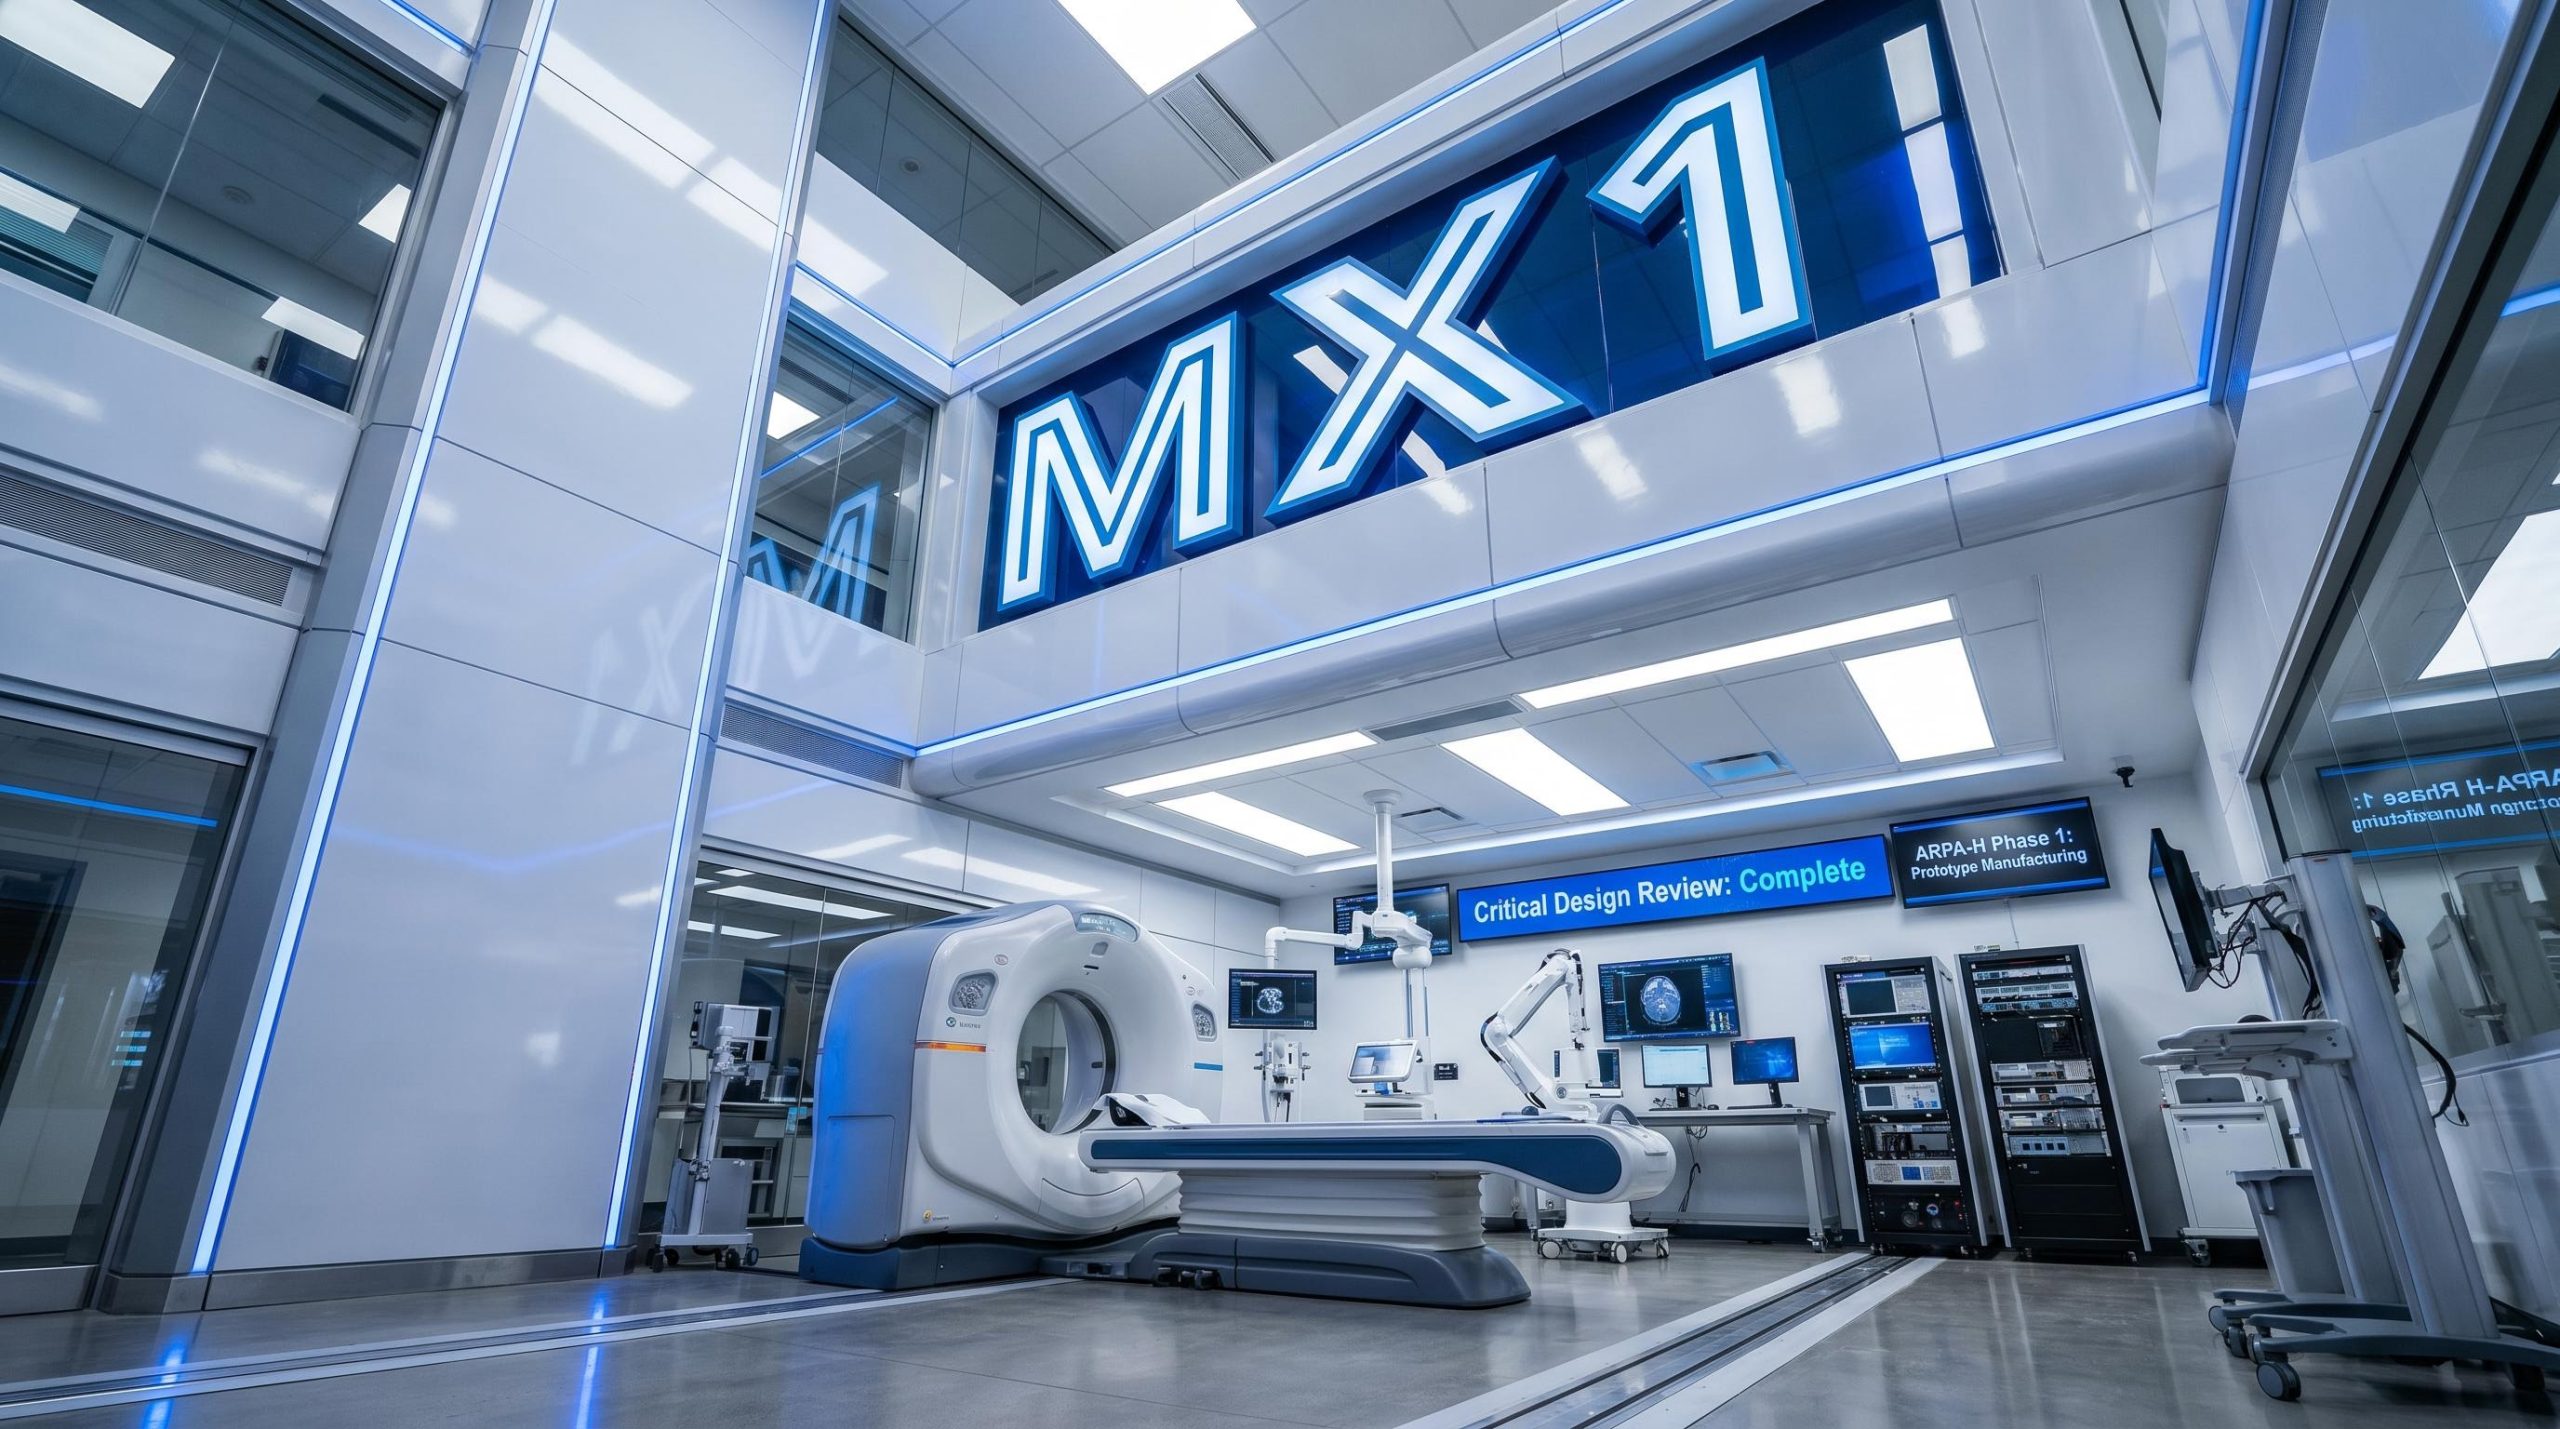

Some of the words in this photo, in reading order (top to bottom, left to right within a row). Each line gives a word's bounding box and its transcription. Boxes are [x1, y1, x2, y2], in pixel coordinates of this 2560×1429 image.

[998, 56, 1813, 611] MX1
[1911, 861, 1978, 879] Prototype
[1981, 850, 2088, 872] Manufacturing
[1915, 838, 1987, 862] ARPA-H
[1991, 831, 2050, 851] Phase
[2055, 827, 2073, 845] 1:
[1474, 895, 1547, 923] Critical
[1555, 887, 1631, 915] Design
[1638, 876, 1732, 905] Review:
[1740, 857, 1867, 894] Complete
